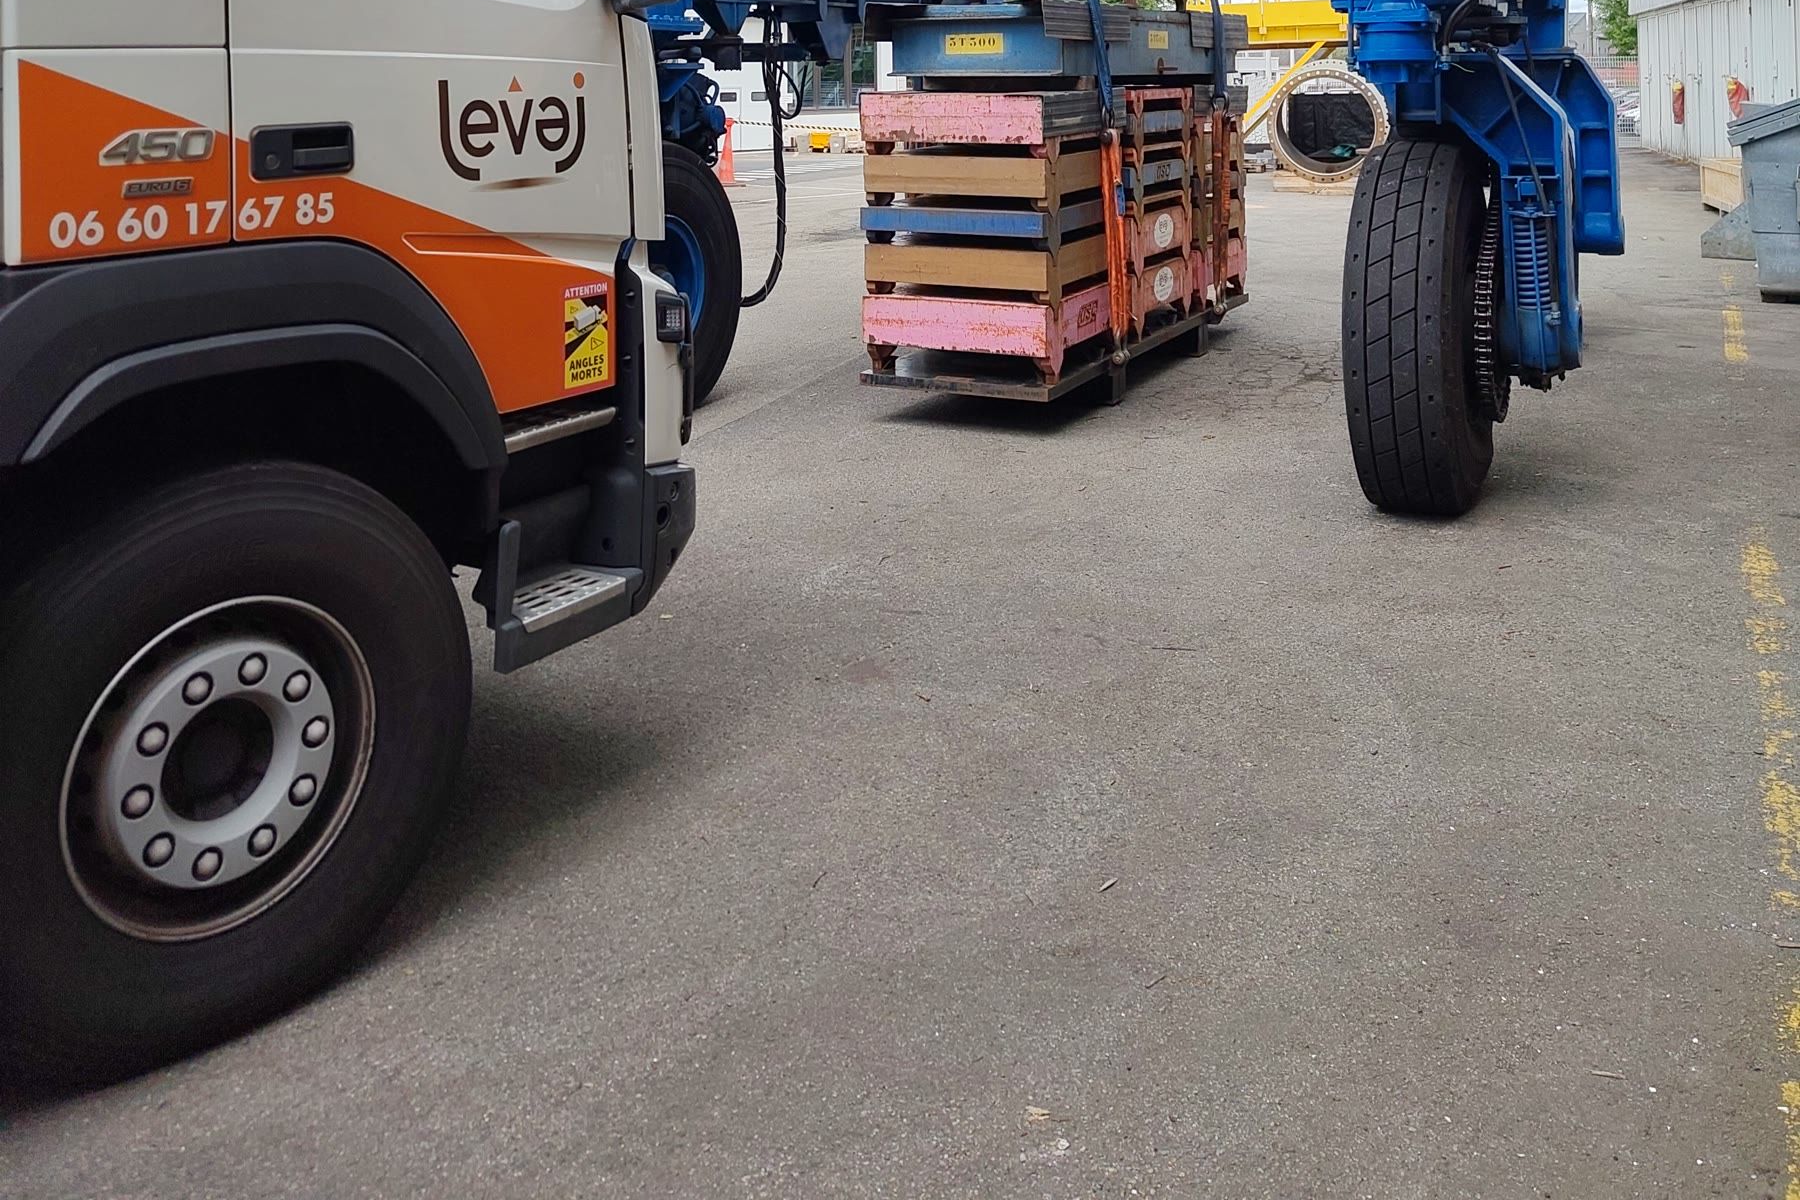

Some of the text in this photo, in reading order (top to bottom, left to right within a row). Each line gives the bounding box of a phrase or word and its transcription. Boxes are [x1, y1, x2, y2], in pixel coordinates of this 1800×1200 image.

[102, 130, 215, 163] 450
[127, 180, 192, 193] EURO 6
[50, 192, 334, 248] 06 60 17 67 85
[564, 282, 608, 298] ATTENTION
[569, 354, 604, 371] ANGLES
[571, 366, 602, 382] MORTS
